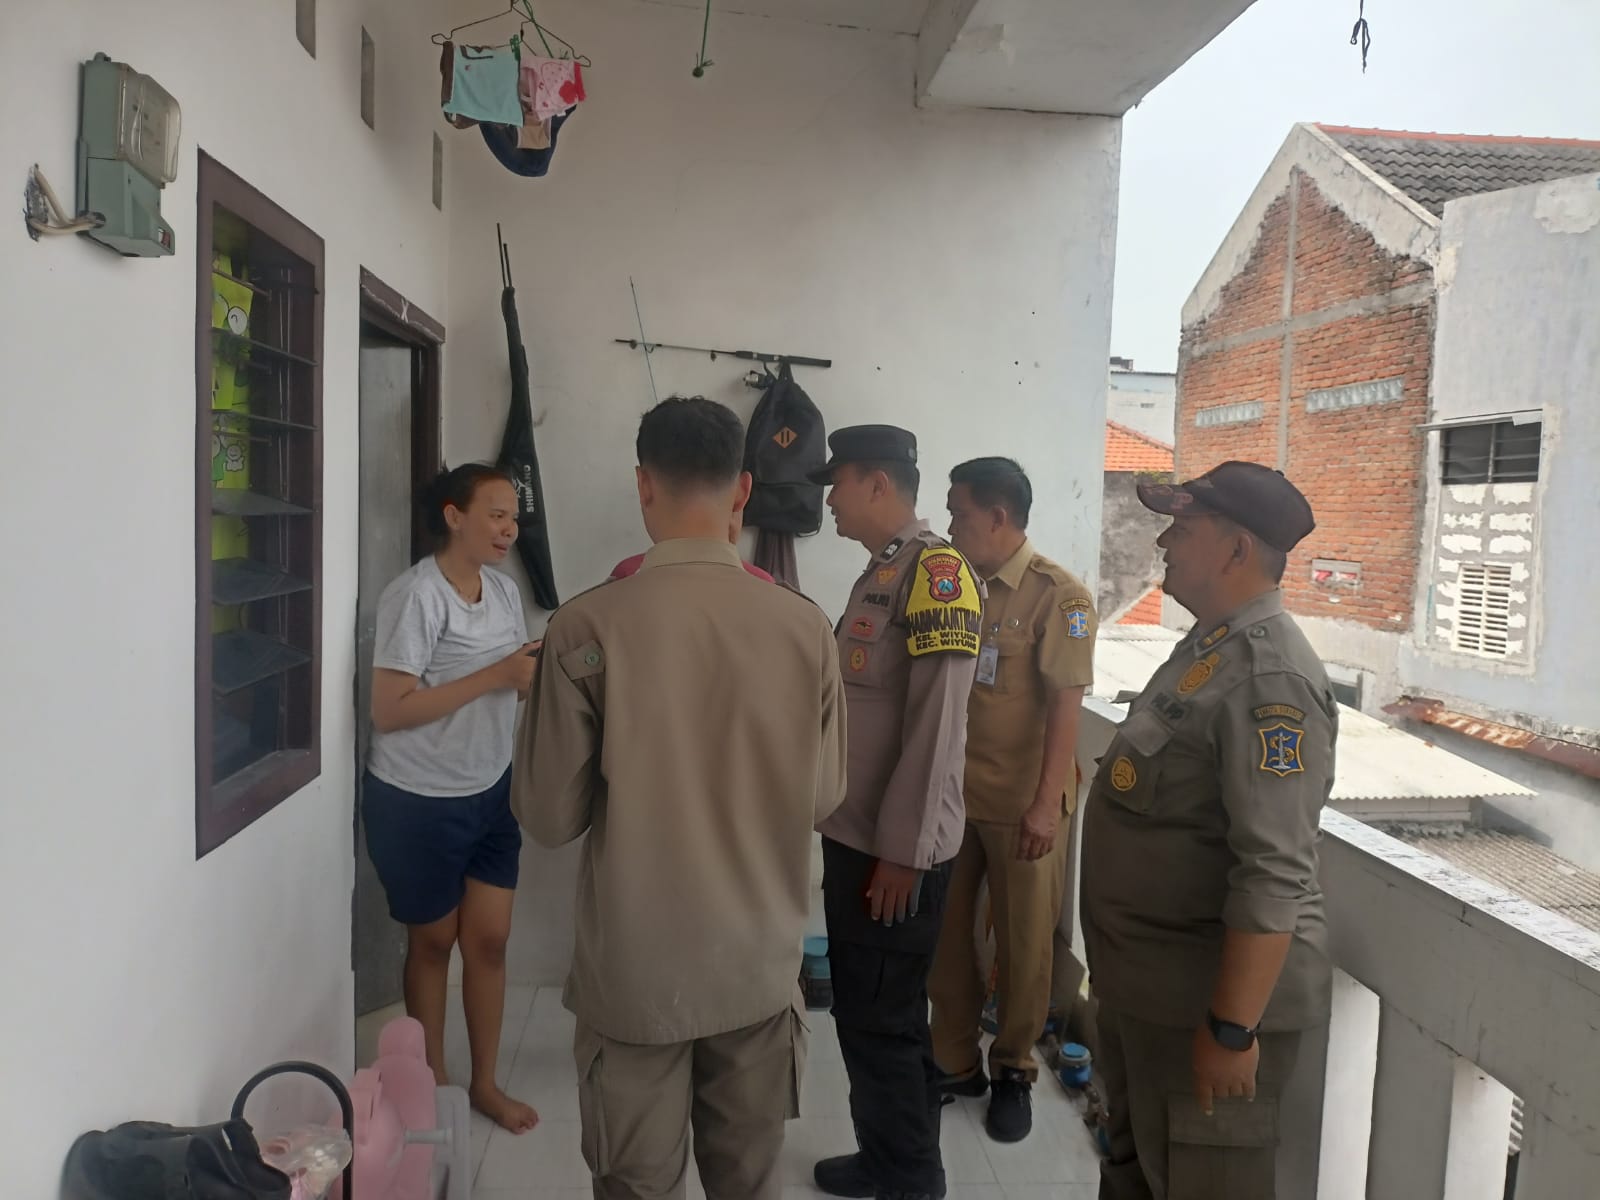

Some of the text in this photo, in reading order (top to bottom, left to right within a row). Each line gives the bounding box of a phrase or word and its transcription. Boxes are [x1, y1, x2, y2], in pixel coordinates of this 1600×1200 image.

[523, 464, 535, 513] SHIMANO
[915, 633, 936, 642] KEL.
[916, 638, 977, 651] KEC. WIYUNG
